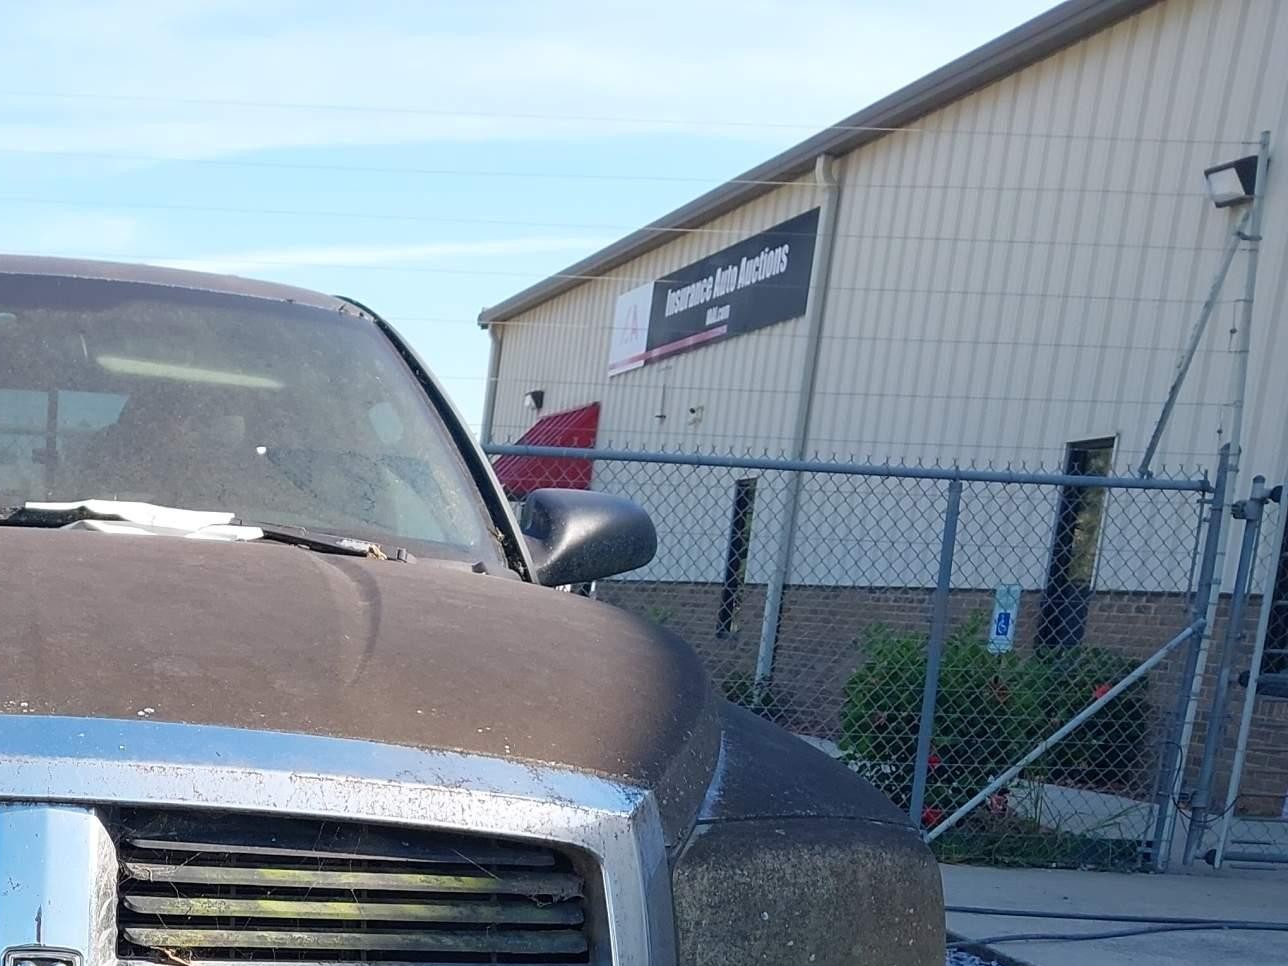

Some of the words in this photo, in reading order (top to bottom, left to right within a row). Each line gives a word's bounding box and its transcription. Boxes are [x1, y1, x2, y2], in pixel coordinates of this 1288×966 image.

[665, 276, 713, 318] Insurance
[713, 265, 738, 299] Auto
[737, 244, 789, 290] Auctions
